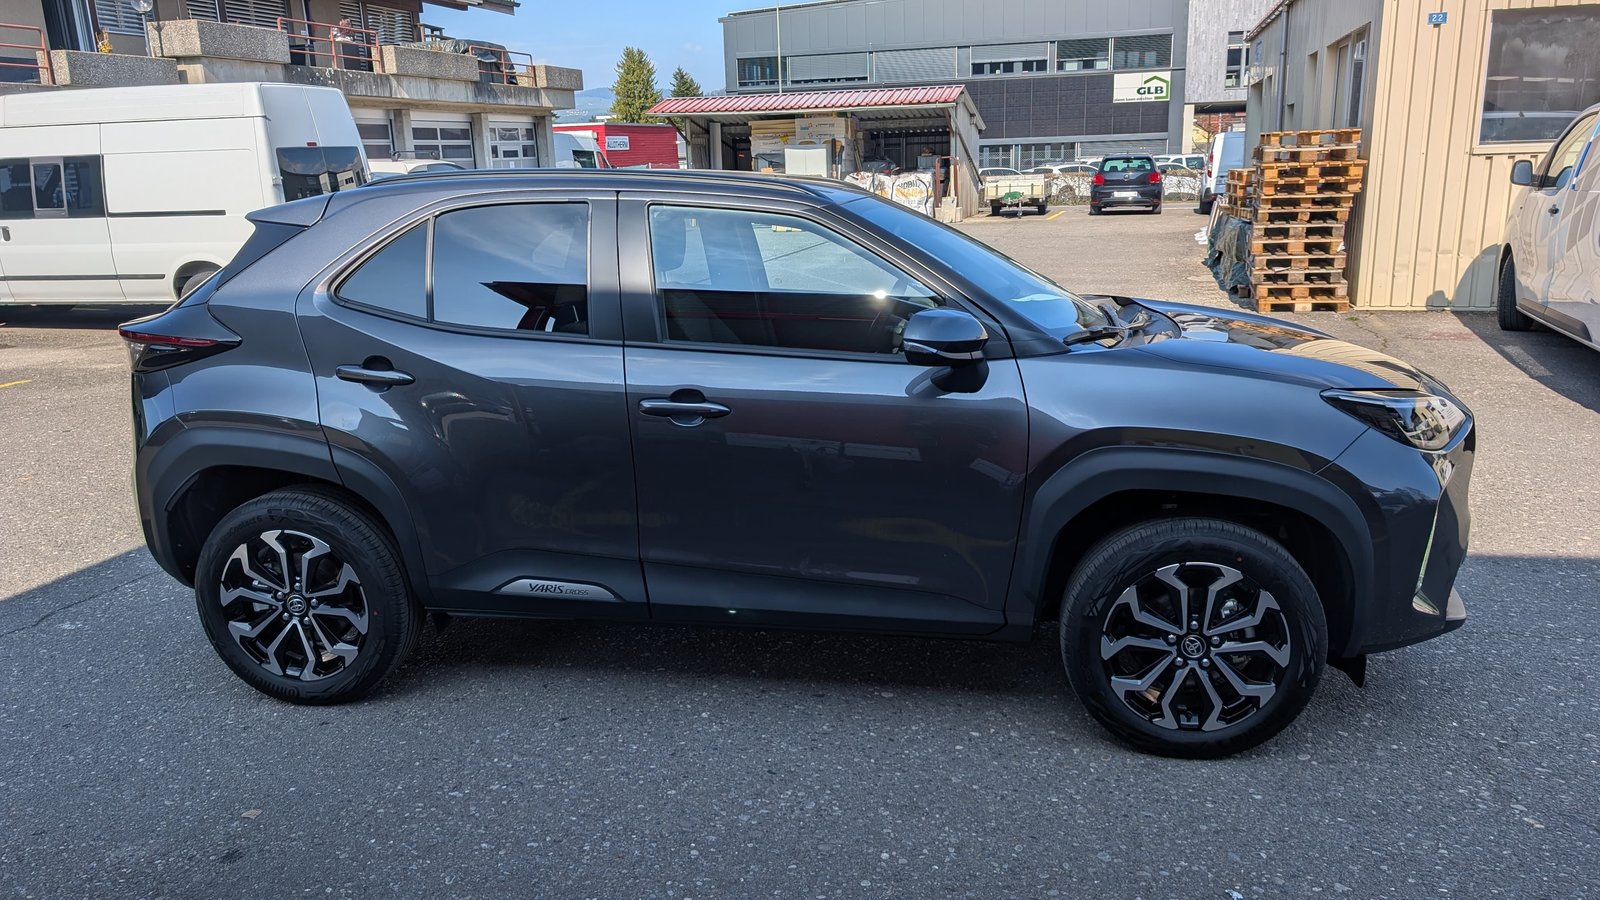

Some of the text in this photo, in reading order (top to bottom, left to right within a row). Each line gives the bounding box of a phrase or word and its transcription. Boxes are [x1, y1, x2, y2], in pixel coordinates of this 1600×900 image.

[1432, 13, 1444, 22] 22
[1136, 86, 1164, 95] GLB
[564, 588, 590, 596] CROSS
